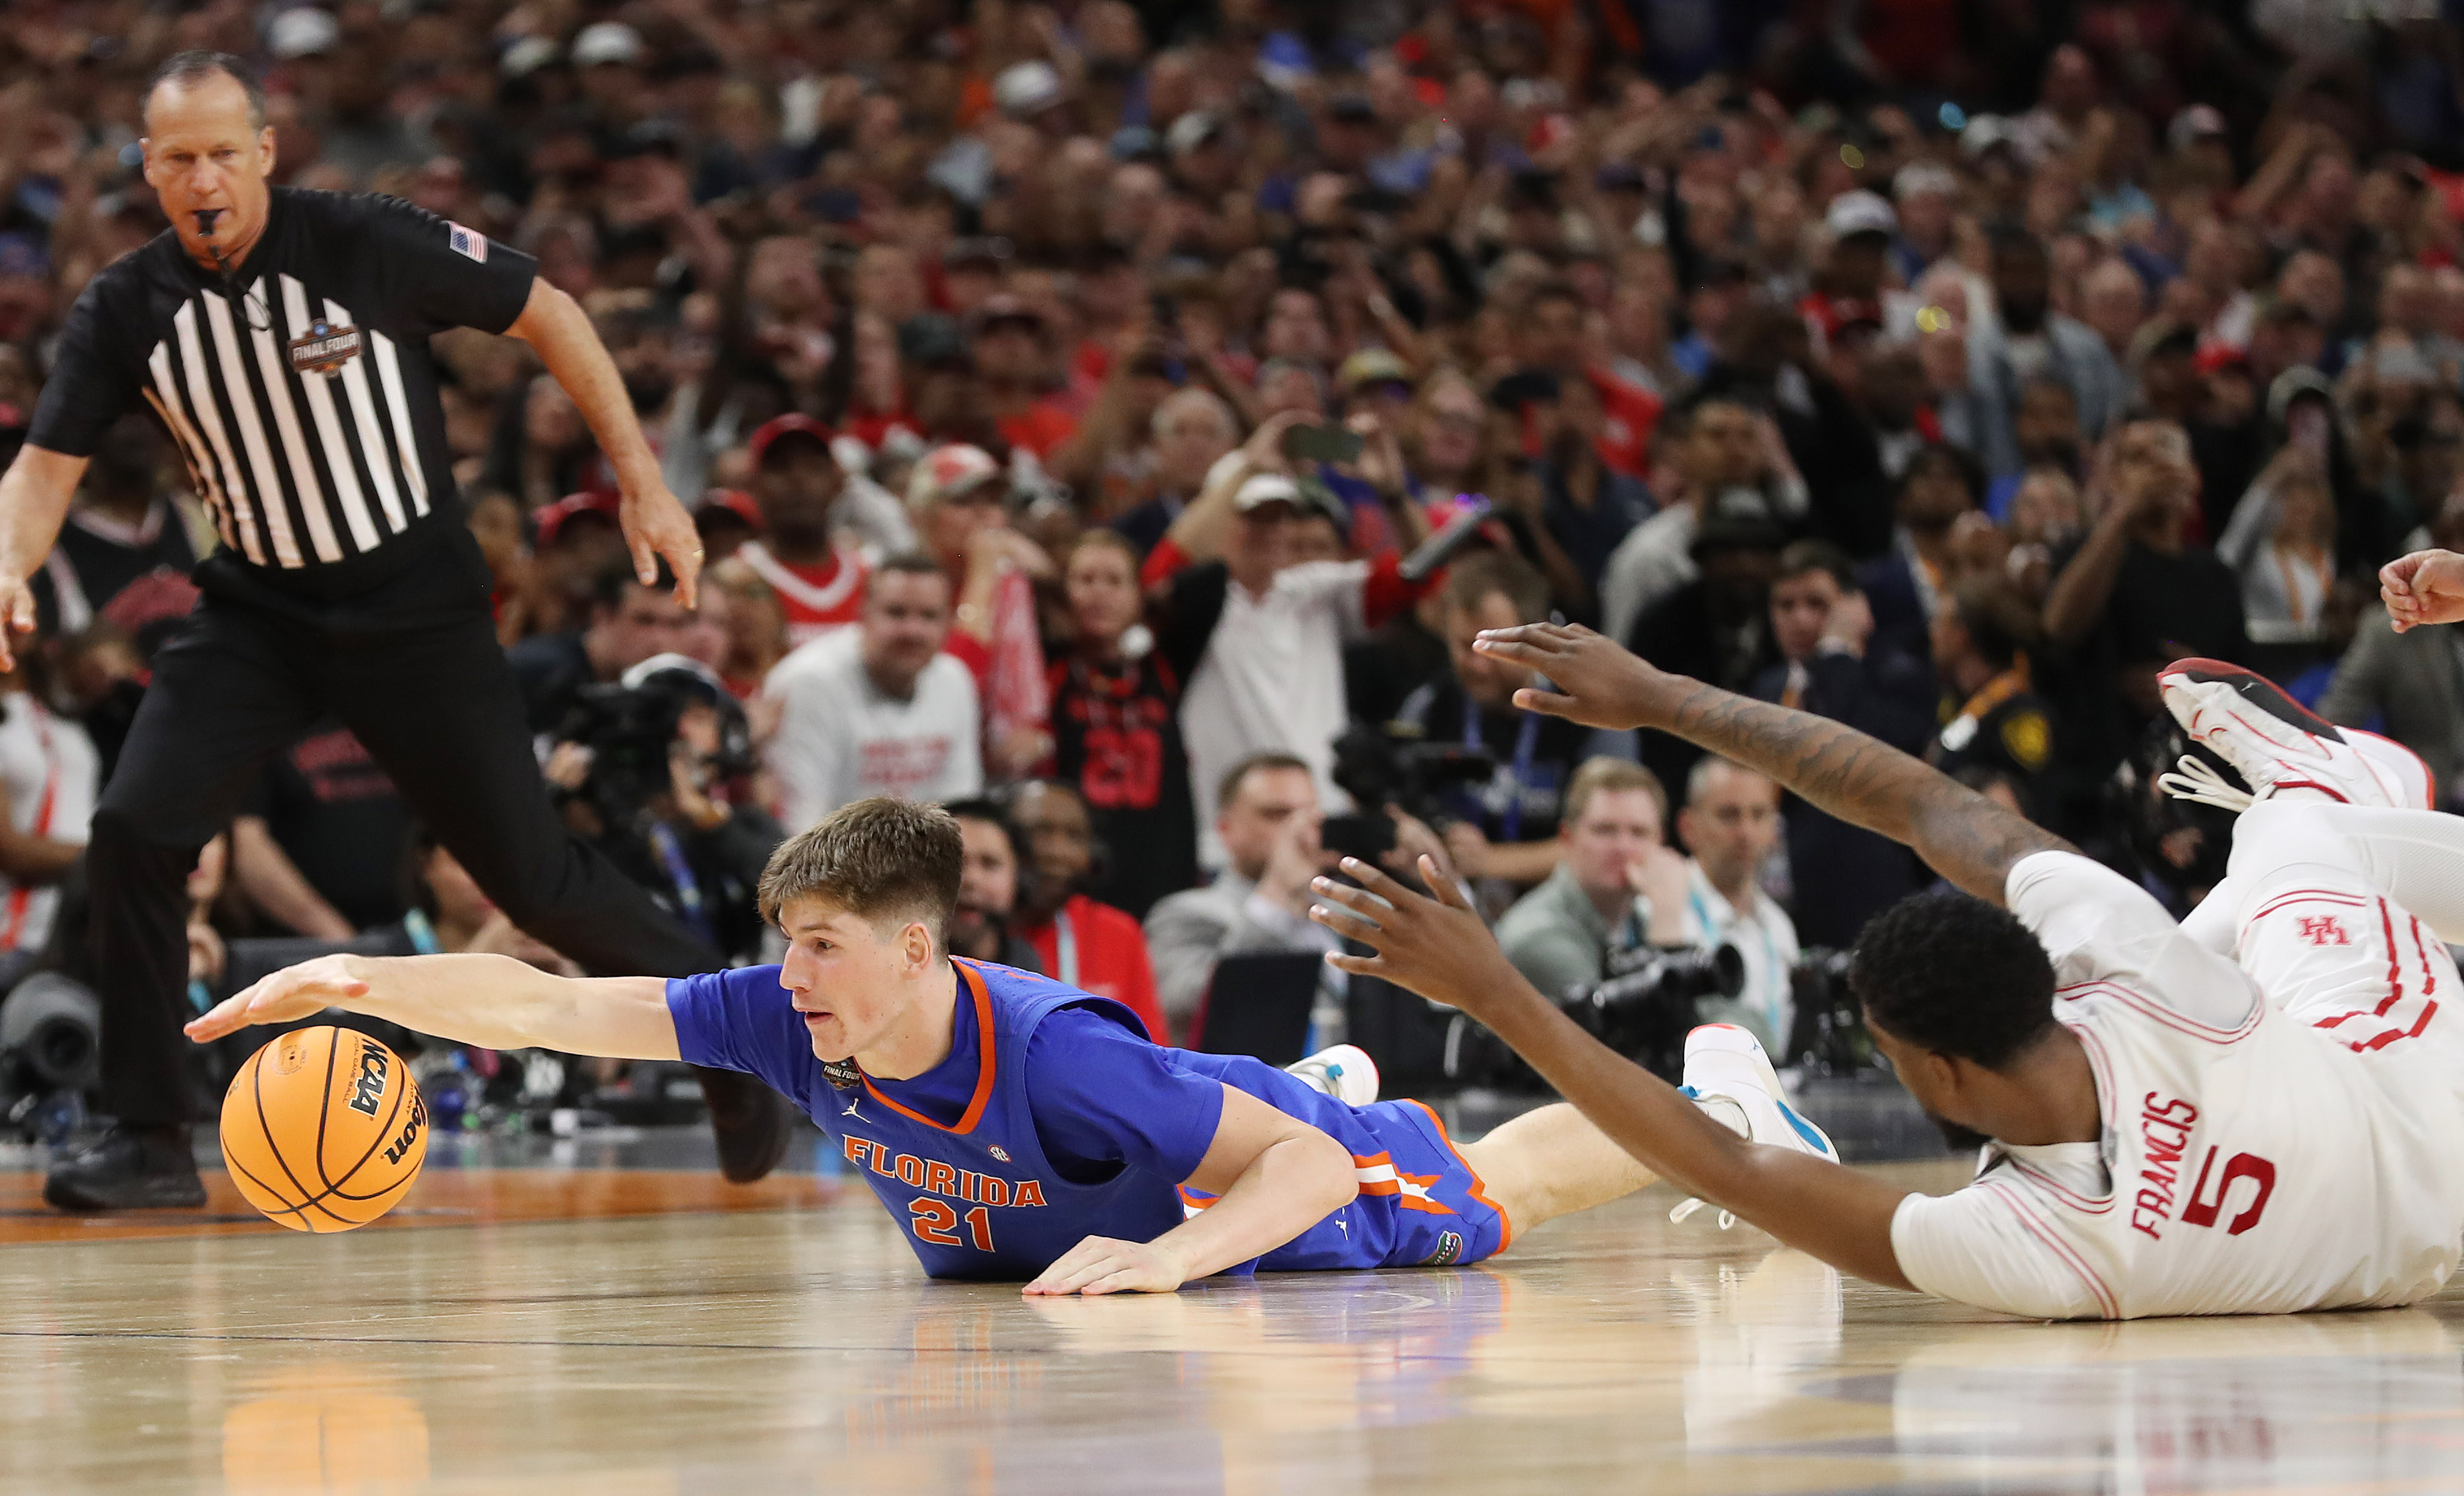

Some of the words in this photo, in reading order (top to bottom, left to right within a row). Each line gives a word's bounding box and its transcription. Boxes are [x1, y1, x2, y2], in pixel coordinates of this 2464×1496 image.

[292, 341, 327, 362] FINAL
[325, 332, 360, 353] FOUR
[343, 1081, 353, 1104] BALL
[349, 1038, 387, 1116] NCAA
[824, 1065, 842, 1077] FINAL
[842, 1070, 860, 1080] FOUR
[384, 1084, 426, 1165] lson
[990, 1146, 1010, 1161] SEC
[842, 1133, 1048, 1207] FLORIDA
[2131, 1091, 2199, 1240] FRANCIS
[2180, 1144, 2277, 1236] 5
[908, 1196, 995, 1253] 21
